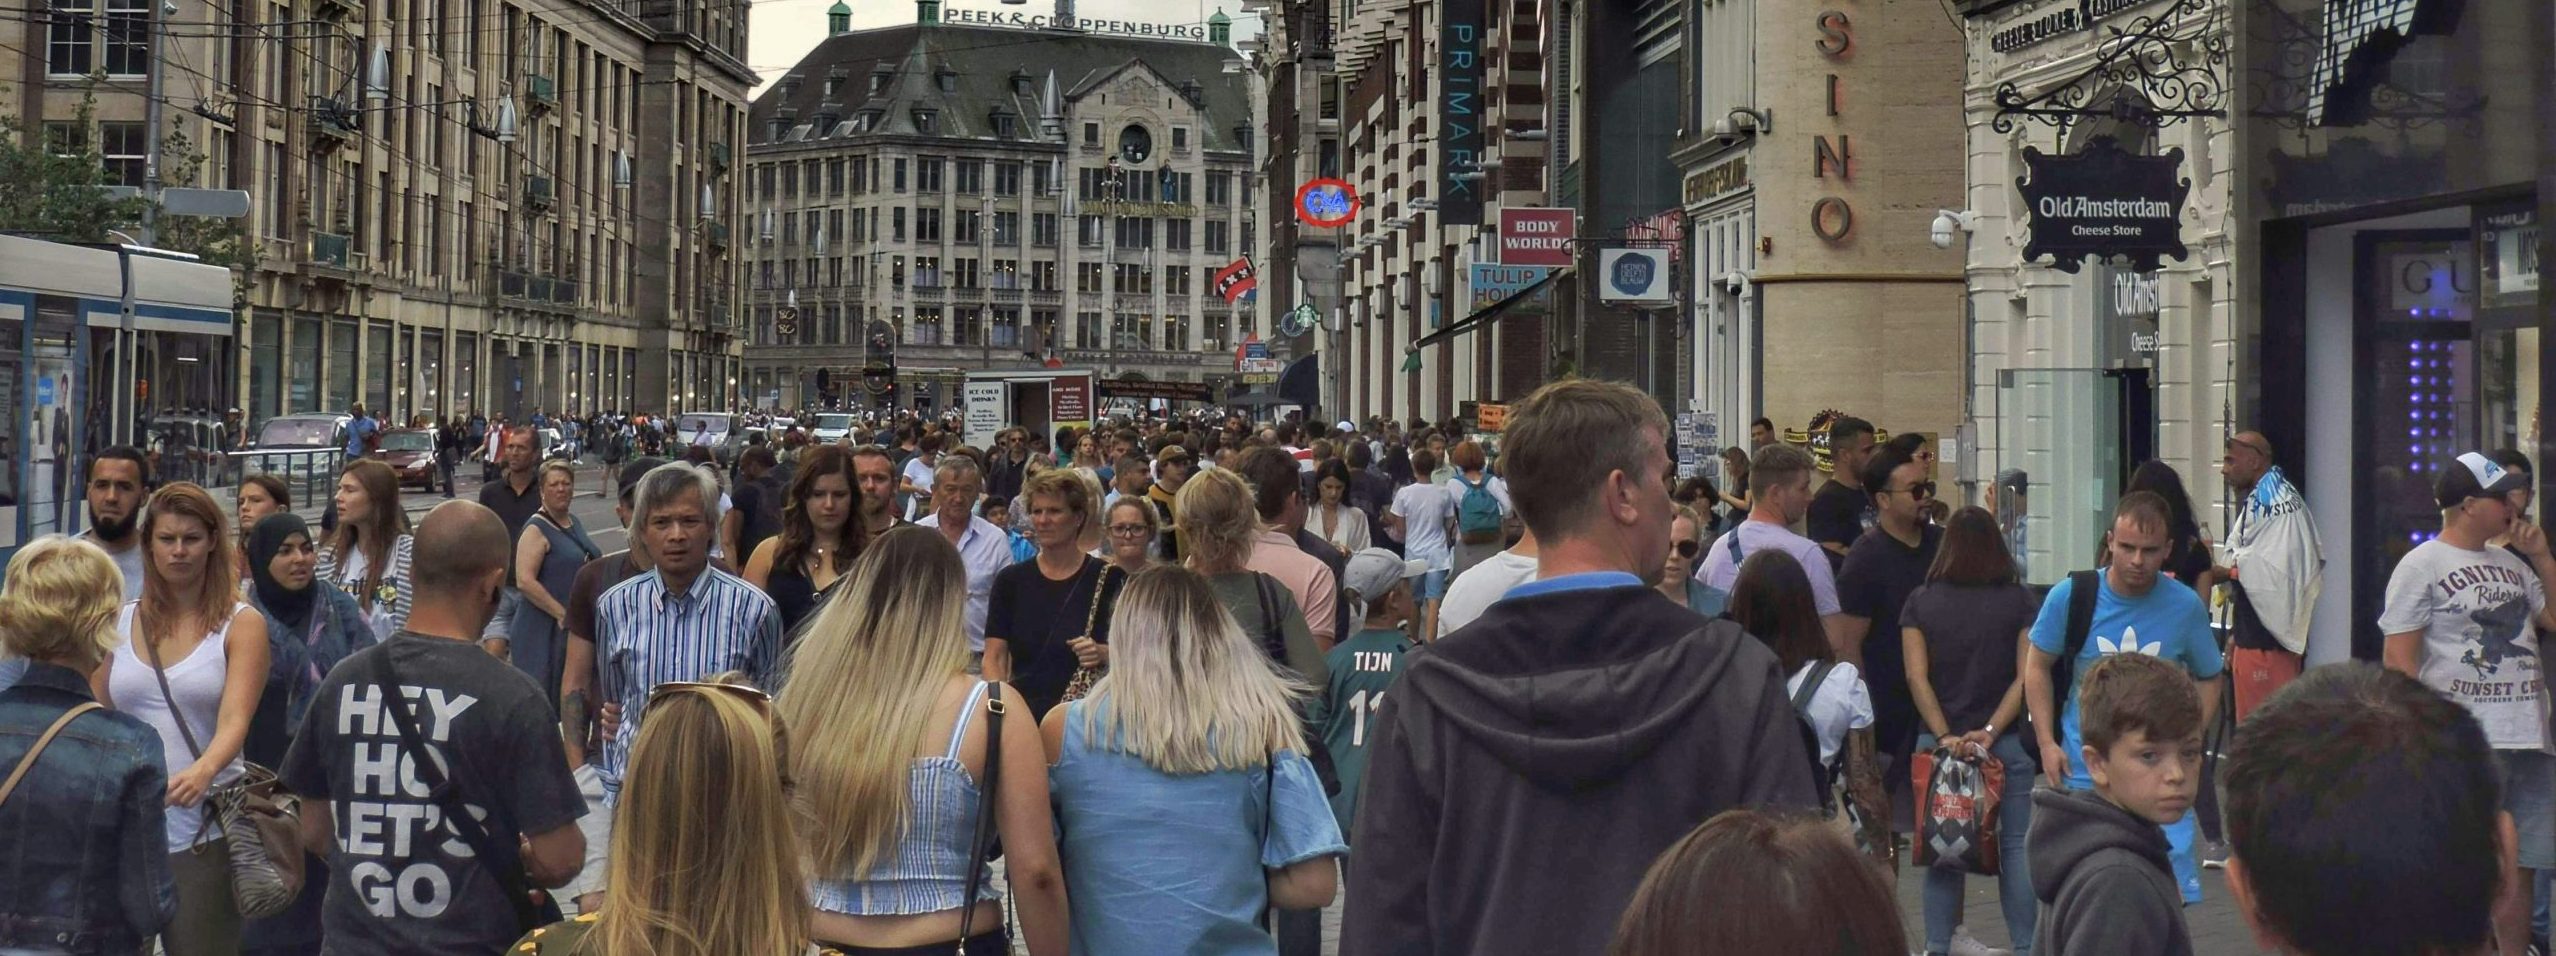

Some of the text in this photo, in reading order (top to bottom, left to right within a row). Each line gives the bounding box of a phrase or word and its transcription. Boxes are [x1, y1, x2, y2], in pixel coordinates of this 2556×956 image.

[946, 8, 1206, 39] PEEK & CLOPPENBURG
[1447, 25, 1473, 196] PRIMARK
[1811, 11, 1851, 241] SINO
[2039, 196, 2171, 218] Old Amsterdam
[1516, 221, 1559, 233] BODY
[2072, 225, 2142, 236] Cheese Store
[1479, 268, 1535, 285] TULIP
[2114, 272, 2160, 317] Old Amst
[2131, 331, 2153, 352] Cheese
[1354, 651, 1393, 672] TIJN
[2450, 679, 2514, 696] SUNSET
[338, 683, 478, 742] HEY
[354, 742, 449, 798] HO
[351, 861, 451, 919] GO
